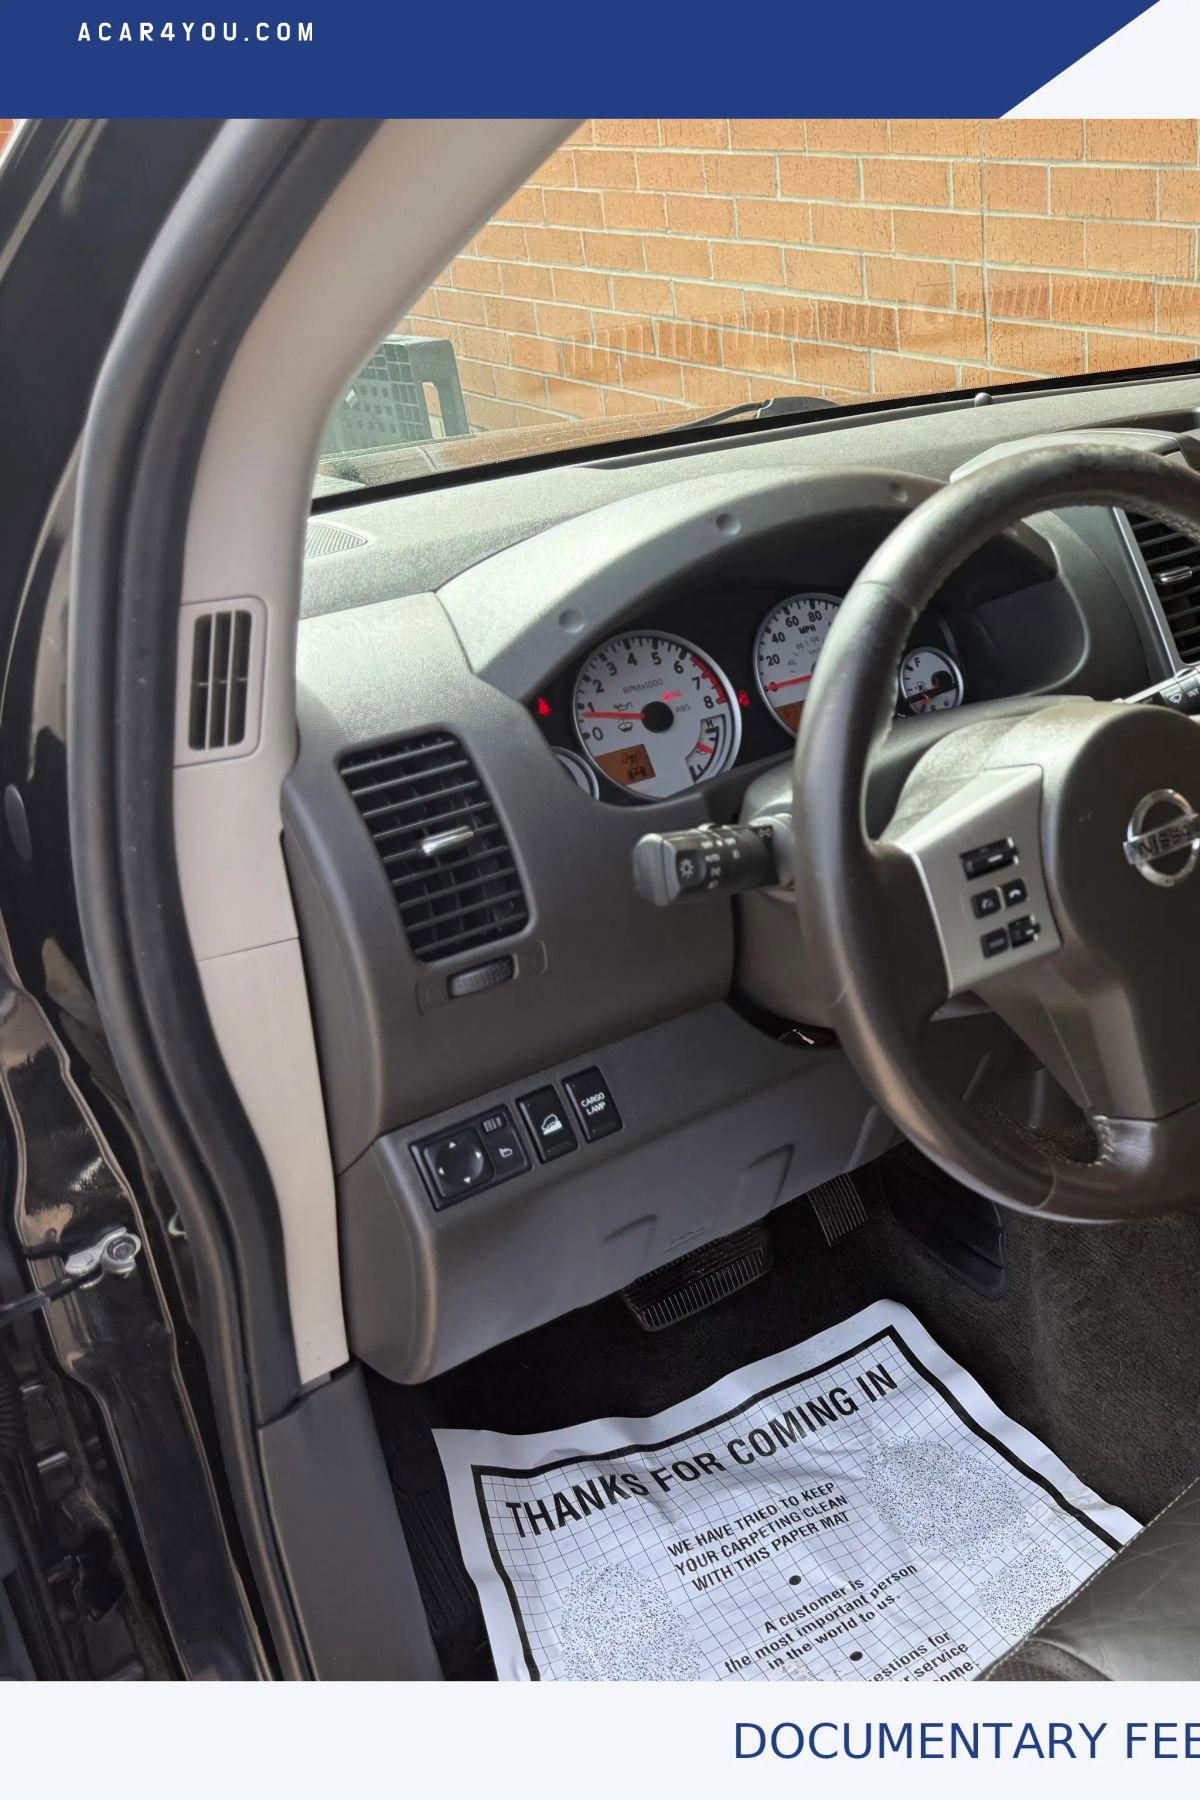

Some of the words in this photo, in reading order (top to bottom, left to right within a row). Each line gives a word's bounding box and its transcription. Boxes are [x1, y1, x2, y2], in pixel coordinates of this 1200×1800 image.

[785, 615, 800, 628] 60
[807, 610, 822, 622] 80
[798, 624, 816, 634] MPH
[771, 632, 786, 643] 40
[626, 652, 638, 666] 4
[650, 652, 662, 666] 5
[765, 653, 780, 666] 20
[914, 657, 921, 667] F
[606, 662, 618, 676] 3
[673, 660, 684, 674] 6
[592, 679, 604, 694] 2
[691, 677, 701, 691] 7
[1188, 688, 1200, 697] INT
[675, 703, 691, 713] ABS
[703, 695, 714, 709] 8
[706, 719, 714, 728] H
[592, 726, 604, 741] 0
[581, 1092, 605, 1107] CARGO
[586, 1101, 606, 1115] LAMP
[505, 1472, 651, 1539] THANKS
[650, 1451, 725, 1493] FOR
[726, 1386, 859, 1466] COMING
[855, 1363, 899, 1403] IN
[667, 1538, 695, 1558] WE
[694, 1523, 735, 1547] HAVE
[734, 1504, 779, 1532] TRIED
[778, 1494, 800, 1510] TO
[800, 1481, 836, 1504] KEEP
[675, 1549, 720, 1577] YOUR
[721, 1511, 801, 1559] CARPETING
[802, 1494, 850, 1518] CLEAN
[691, 1564, 734, 1592] WITH
[734, 1546, 771, 1572] THIS
[771, 1522, 820, 1552] PAPER
[819, 1510, 851, 1530] MAT
[763, 1620, 778, 1634] A
[779, 1587, 848, 1628] customer
[848, 1579, 865, 1593] is
[724, 1654, 751, 1674] the
[754, 1632, 795, 1660] most
[794, 1594, 869, 1638] important
[870, 1563, 918, 1601] person
[766, 1656, 785, 1671] in
[786, 1641, 813, 1662] the
[814, 1619, 859, 1646] world
[858, 1609, 876, 1624] to
[877, 1594, 902, 1612] us.
[868, 1644, 928, 1682] estions
[927, 1631, 951, 1647] for
[913, 1643, 969, 1678] service
